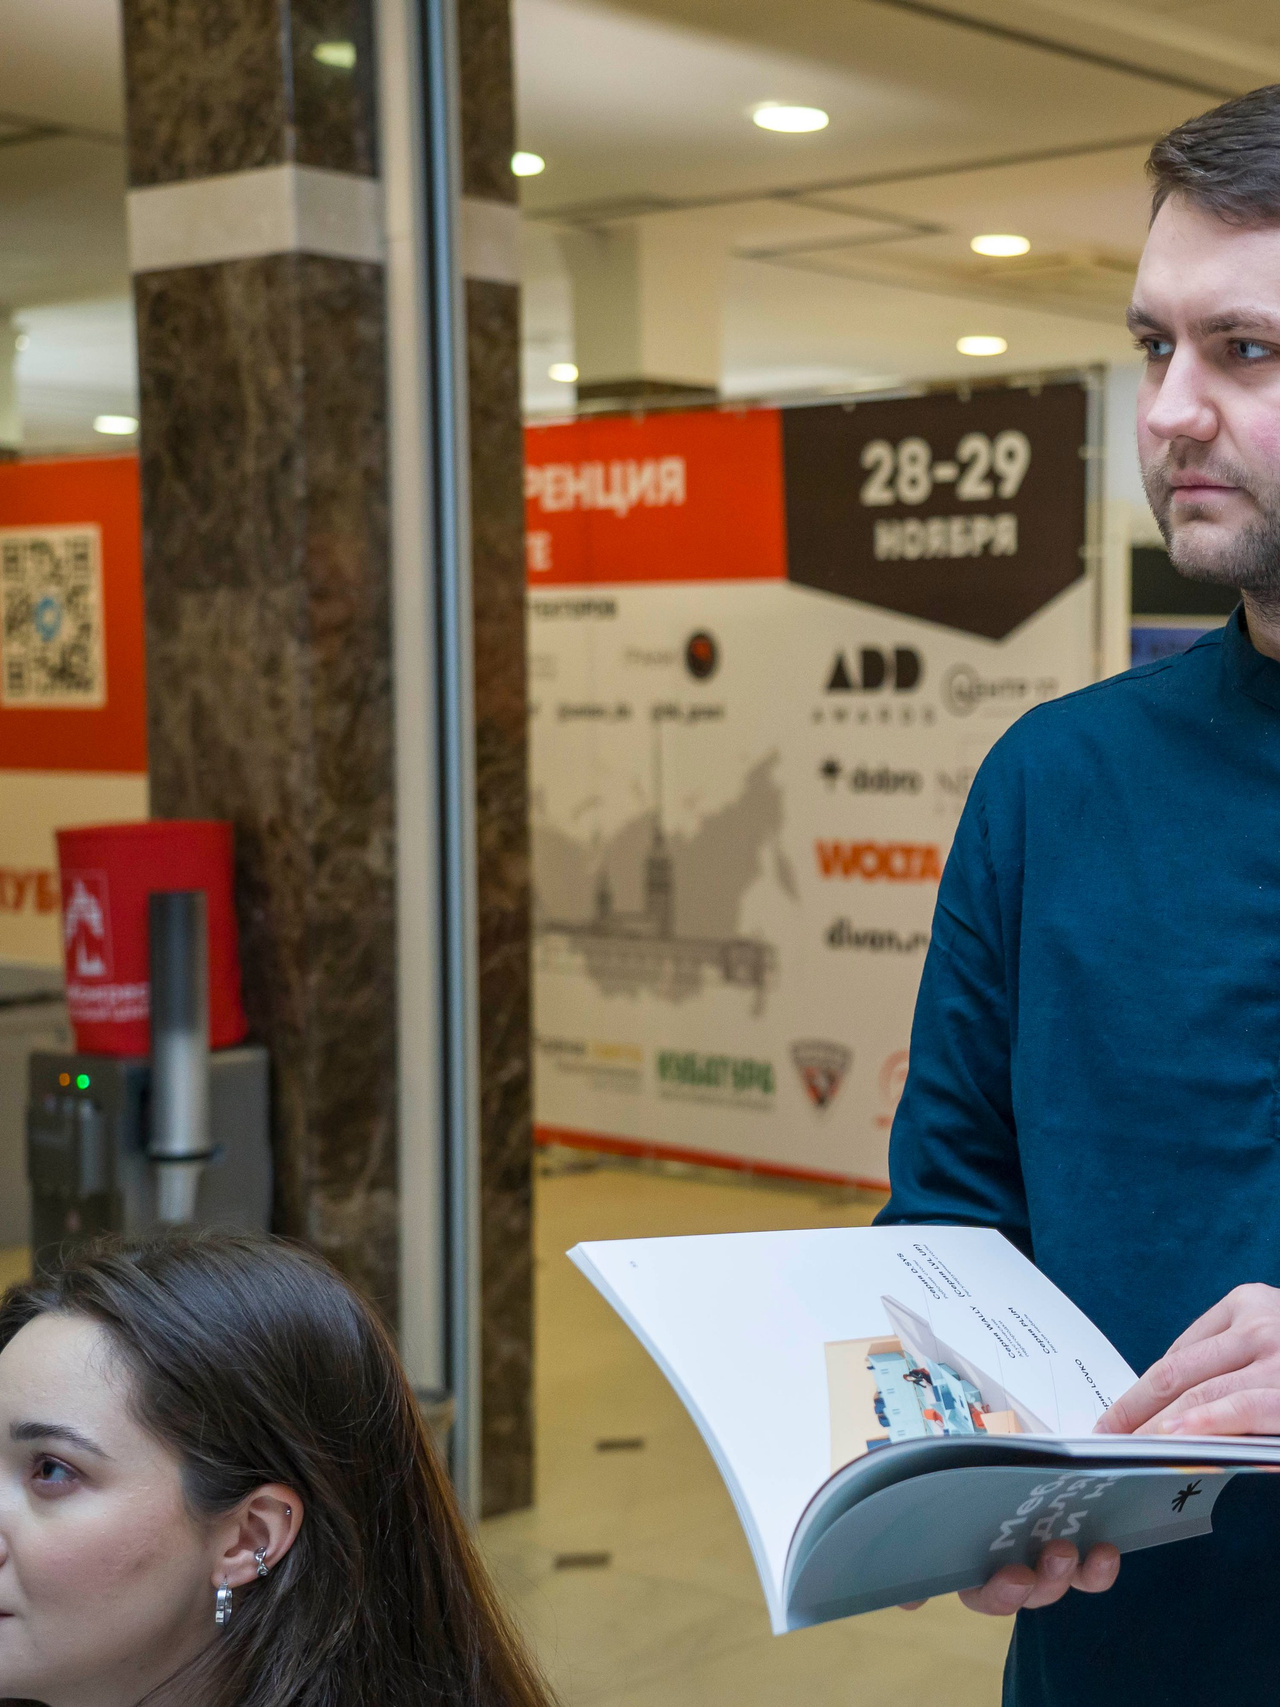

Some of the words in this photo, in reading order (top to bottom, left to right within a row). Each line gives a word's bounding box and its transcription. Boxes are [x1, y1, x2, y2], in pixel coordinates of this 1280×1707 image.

[859, 430, 1031, 506] 28-29
[874, 513, 1018, 561] НОЯБРЯ
[826, 647, 925, 693] ADD
[827, 917, 931, 952] divan.r
[917, 1275, 940, 1300] Серия
[969, 1305, 994, 1331] WALLY
[1008, 1306, 1028, 1327] PLUM
[993, 1332, 1016, 1359] Серия
[1027, 1328, 1050, 1354] Серия
[1074, 1358, 1096, 1388] LOVKO
[1095, 1390, 1110, 1410] рия
